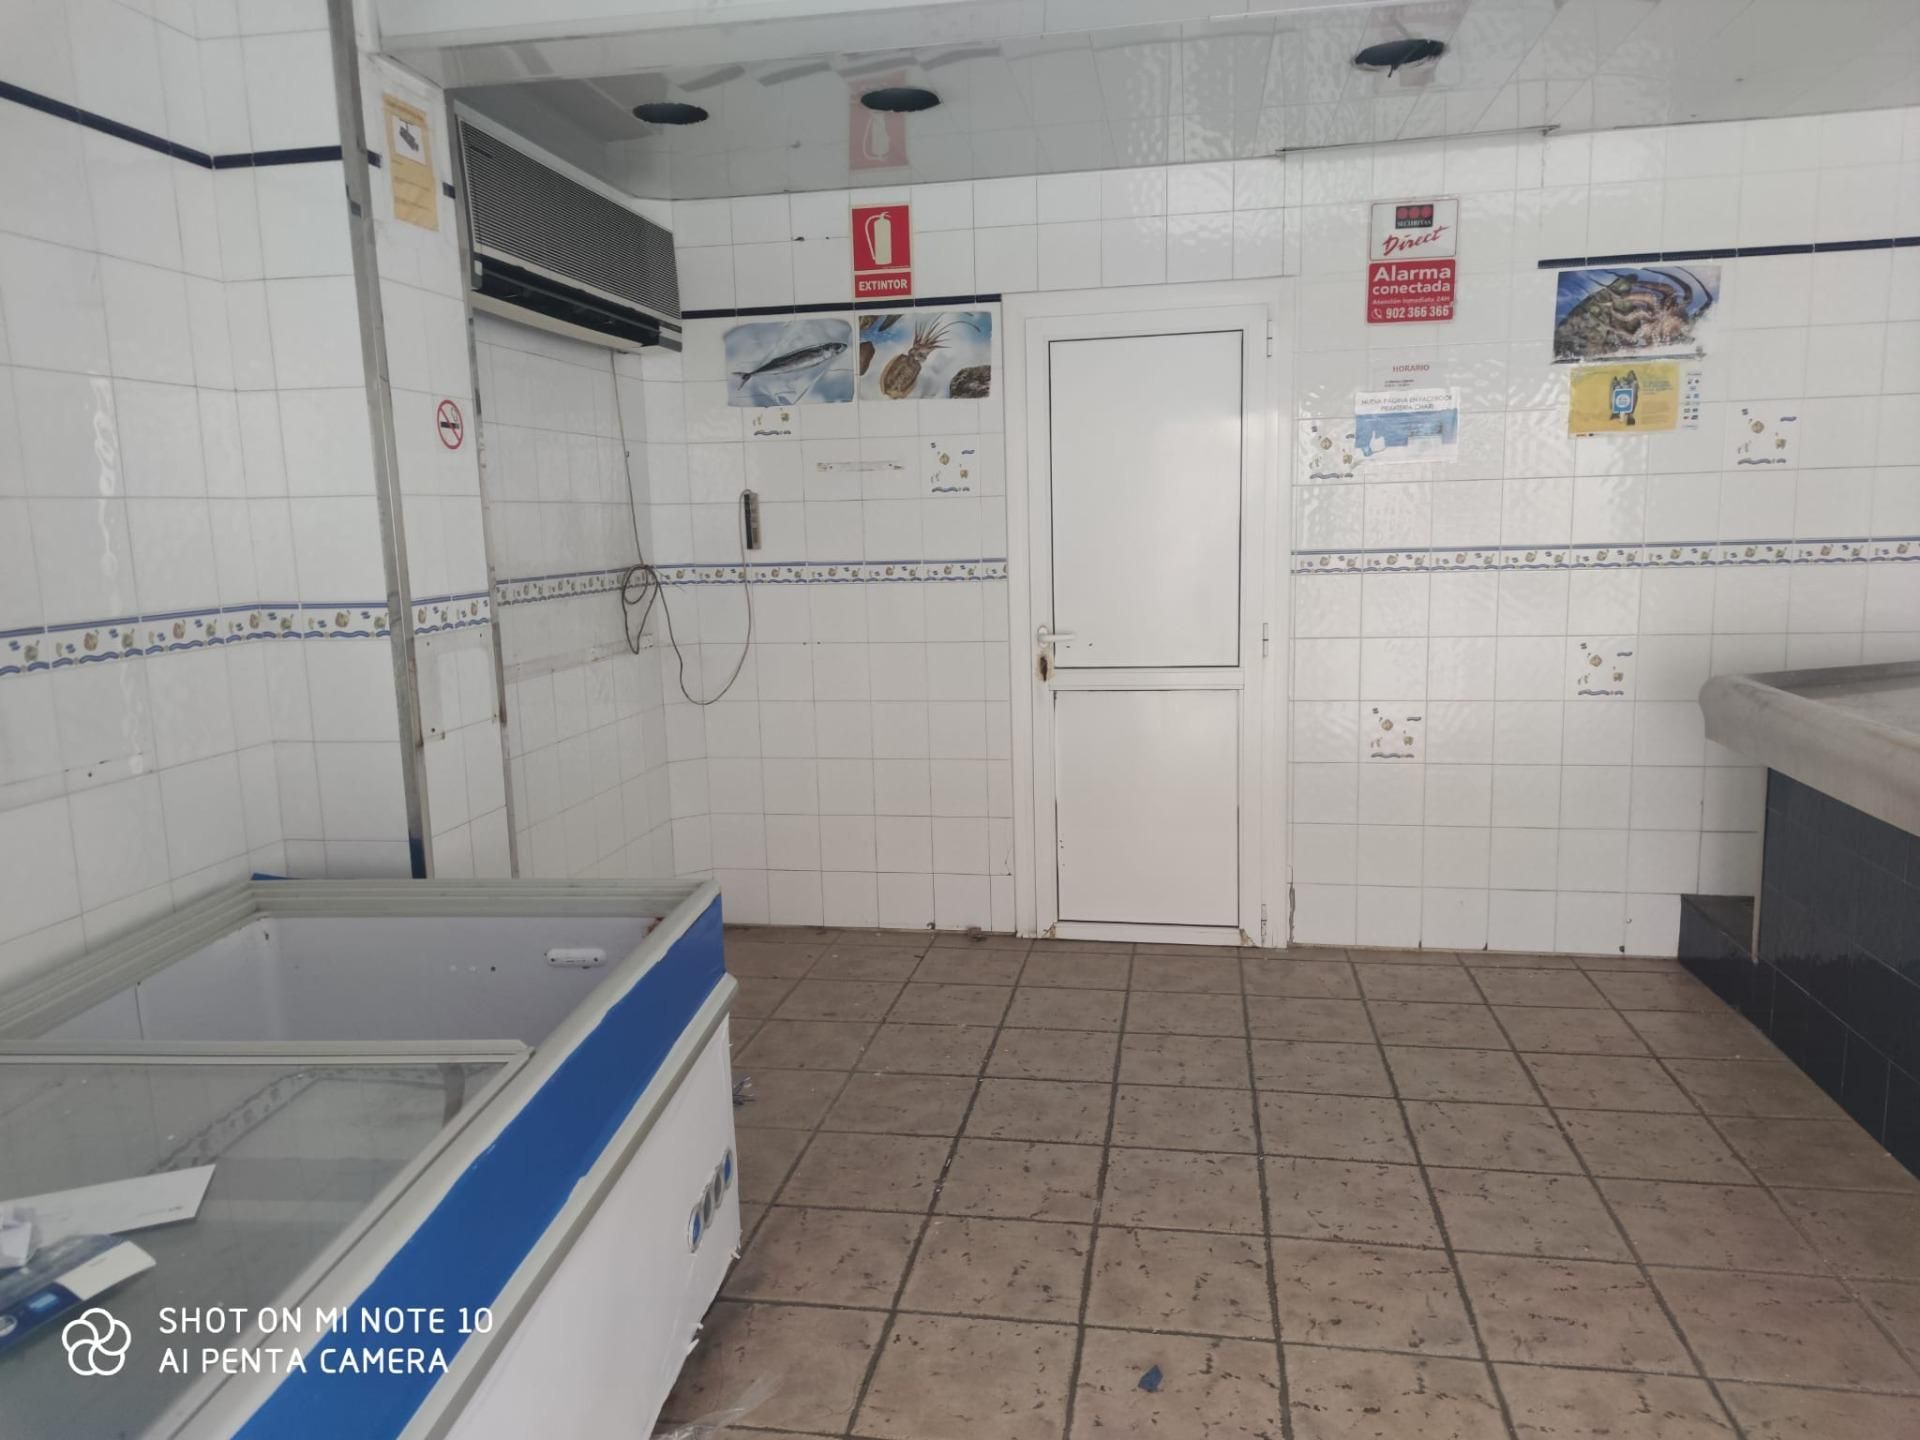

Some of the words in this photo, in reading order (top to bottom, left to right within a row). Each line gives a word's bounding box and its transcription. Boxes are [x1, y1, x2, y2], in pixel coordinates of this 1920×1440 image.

[1383, 226, 1450, 256] Direct
[1373, 265, 1451, 282] Alarma
[859, 279, 907, 291] EXTINTOR
[1372, 281, 1451, 295] conectada
[1386, 307, 1406, 319] 902
[1407, 306, 1428, 318] 366
[1429, 305, 1449, 317] 366
[1392, 364, 1430, 373] HORARIO
